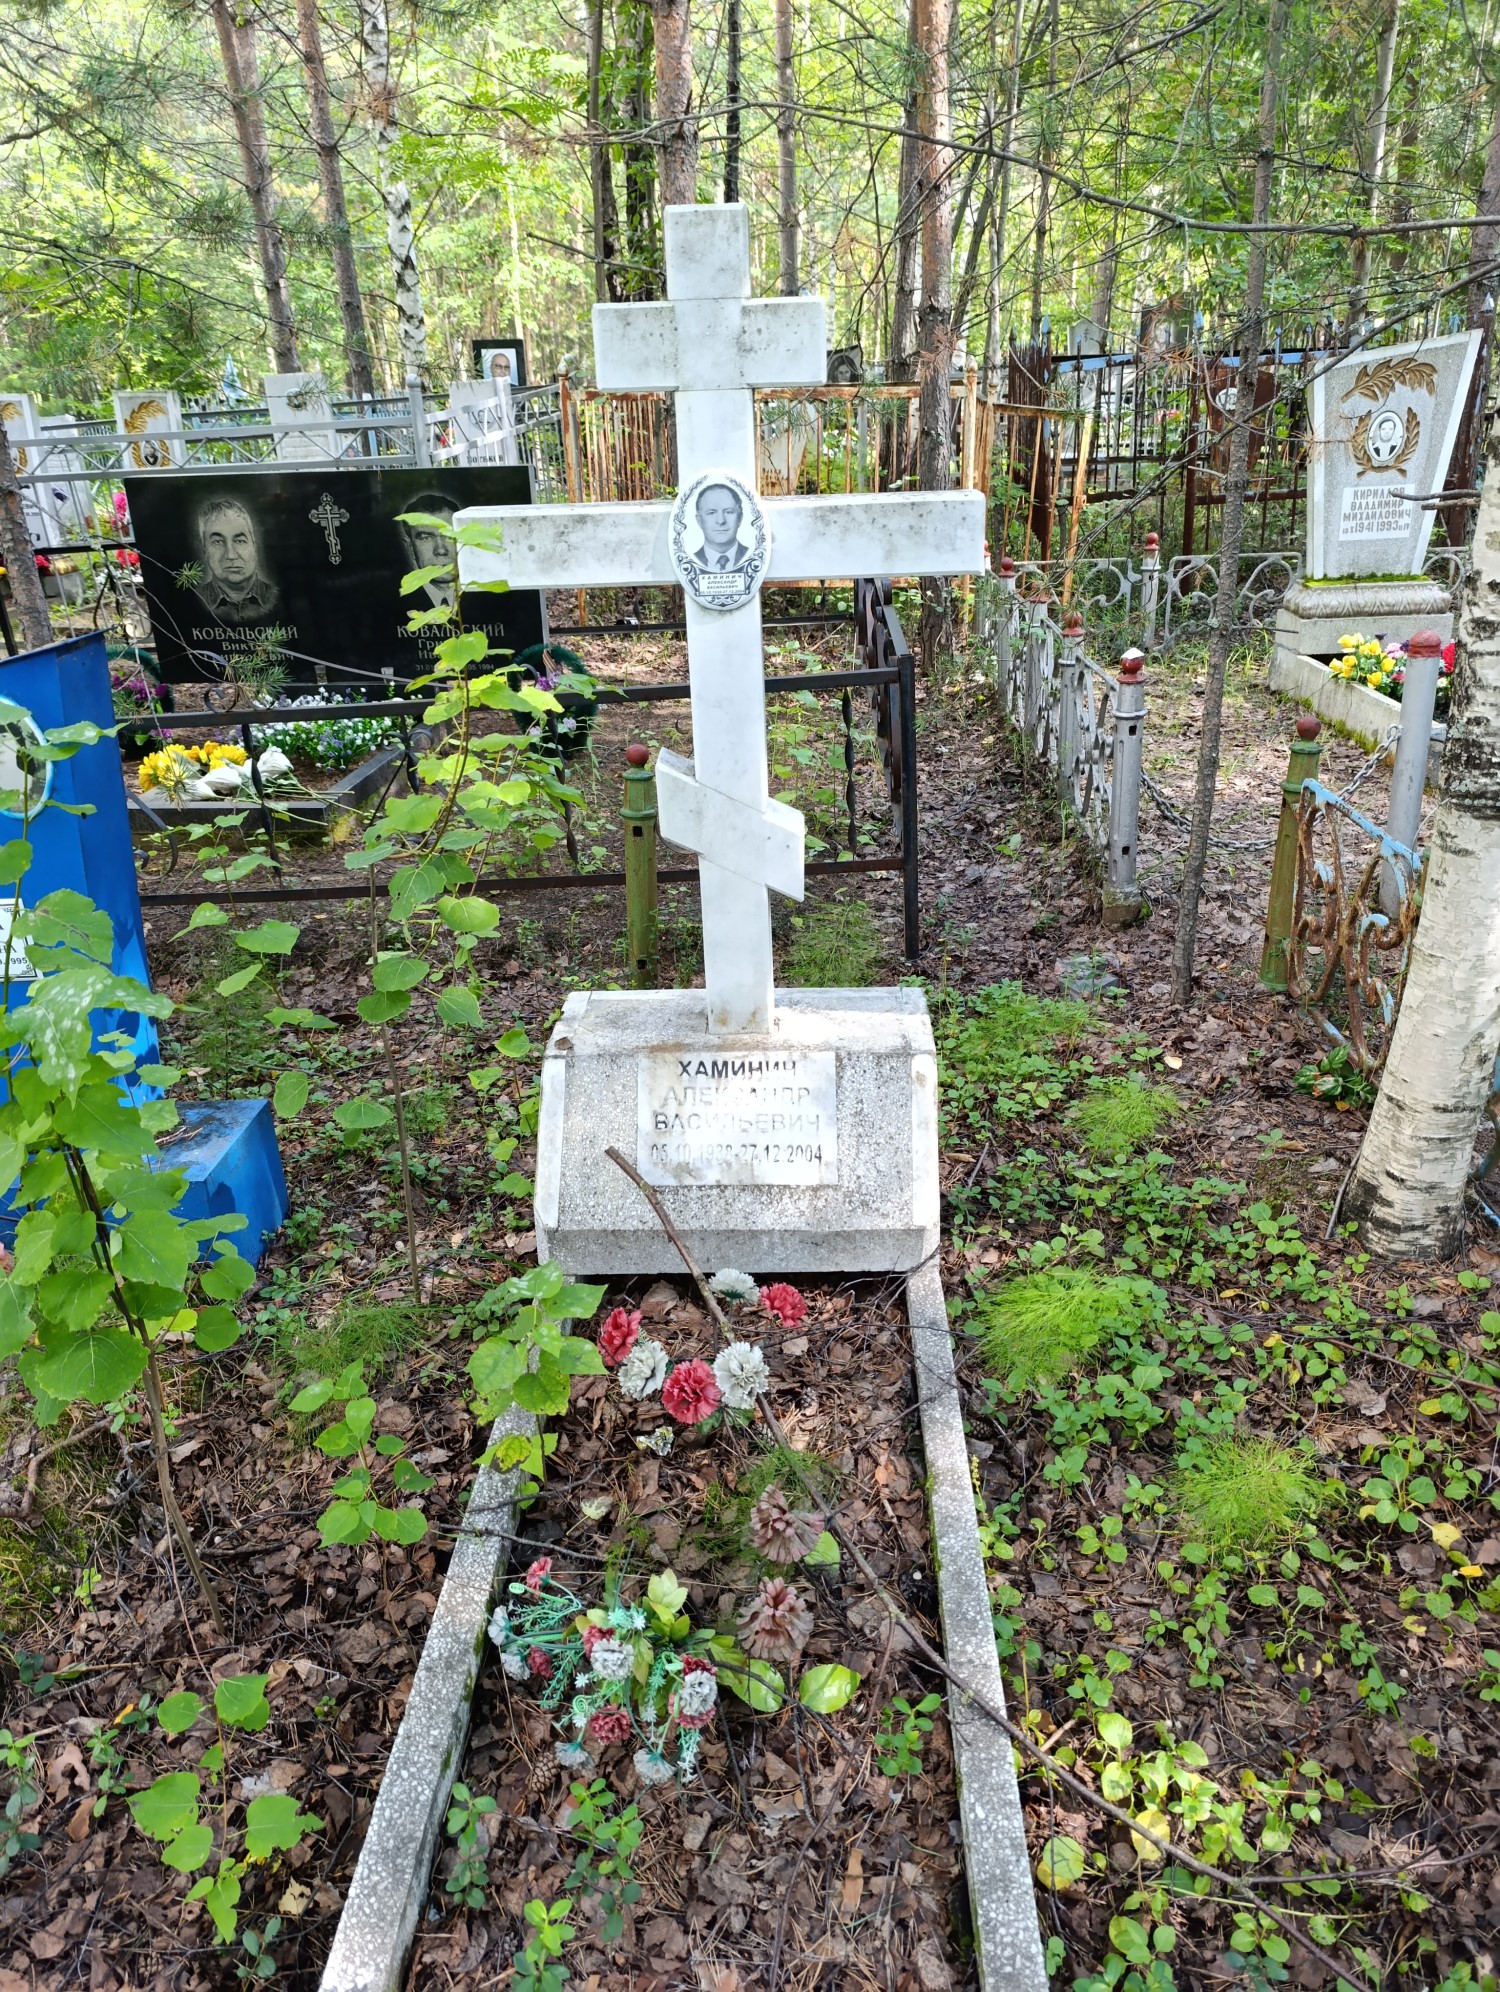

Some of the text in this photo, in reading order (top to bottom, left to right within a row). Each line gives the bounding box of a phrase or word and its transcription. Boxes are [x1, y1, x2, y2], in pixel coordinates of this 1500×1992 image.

[1350, 500, 1404, 511] ВЛАДИМИР
[191, 625, 299, 641] КОВАЛЬСКИЙ
[396, 623, 506, 638] КОВАЛЬСКИЙ
[221, 641, 261, 652] Викт
[679, 1059, 797, 1079] ХАМИНИЧ
[653, 1112, 821, 1134] ВАСИЛЬЕВИЧ
